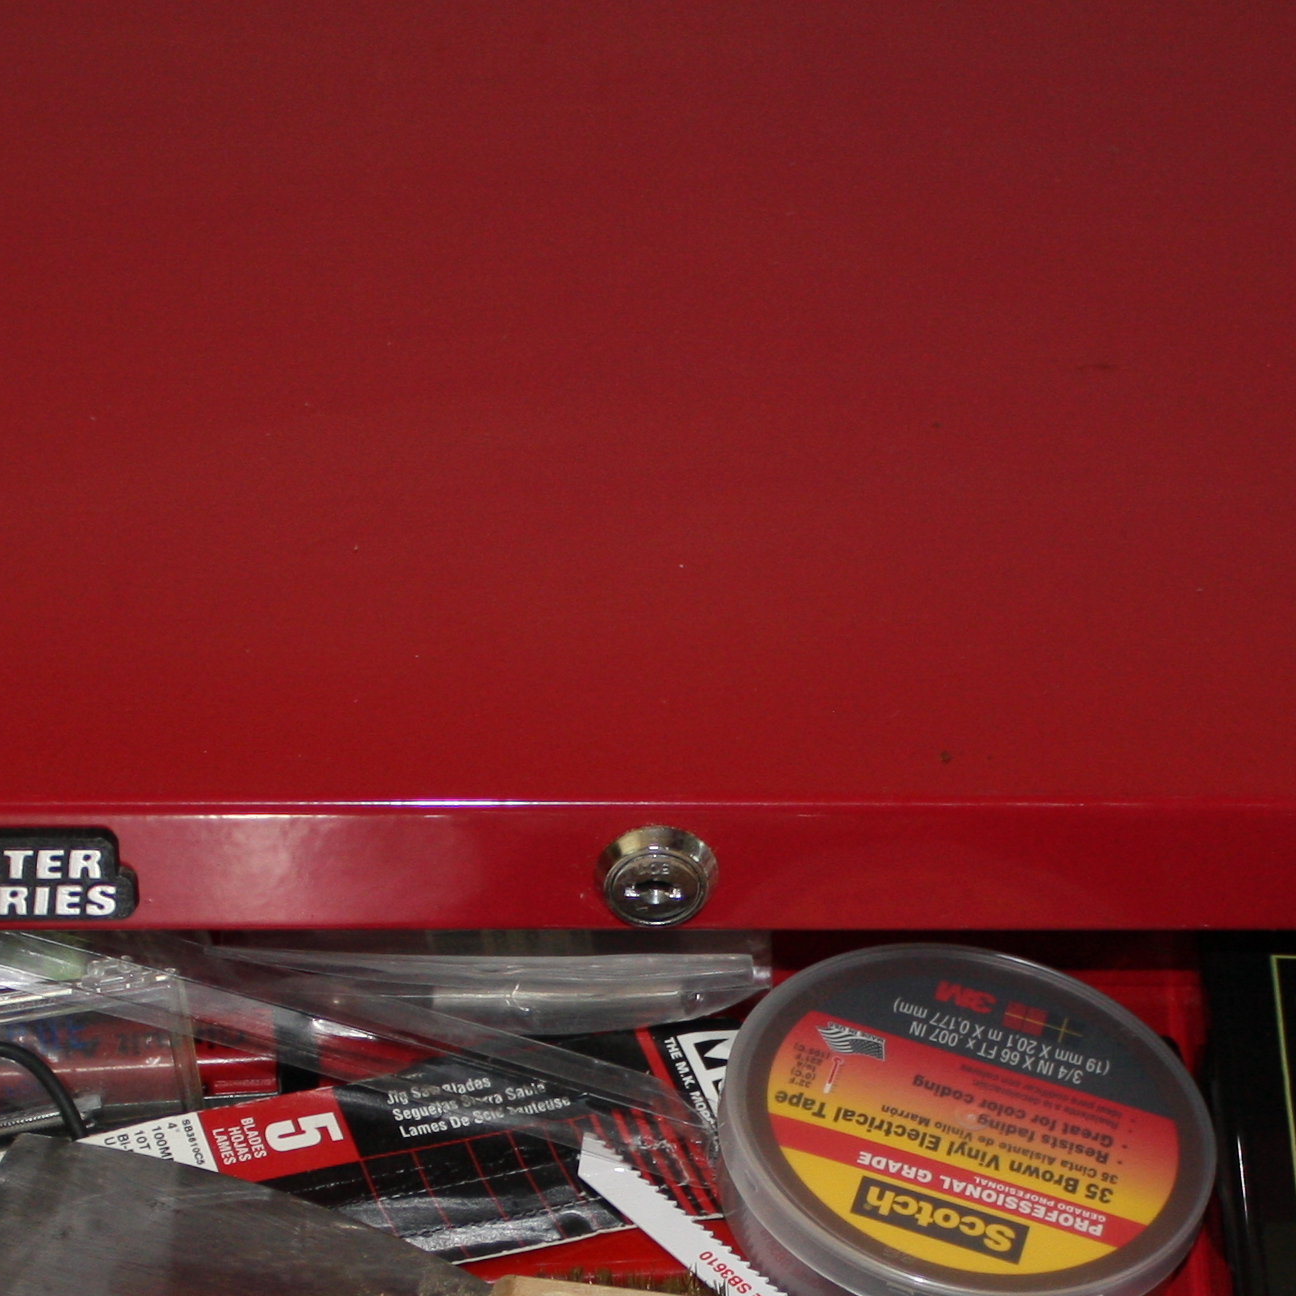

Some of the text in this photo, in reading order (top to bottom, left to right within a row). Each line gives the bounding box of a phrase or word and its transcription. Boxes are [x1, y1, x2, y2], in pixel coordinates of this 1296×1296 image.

[933, 980, 999, 1014] 3M
[893, 998, 927, 1020] mm)
[909, 1021, 927, 1037] IN
[929, 1029, 962, 1047] .007
[987, 1029, 1002, 1042] m
[977, 1043, 998, 1059] FT
[1000, 1049, 1020, 1065] 66
[1054, 1049, 1083, 1066] mm
[664, 1036, 683, 1060] THE
[674, 1061, 695, 1089] M.K.
[1037, 1060, 1054, 1075] IN
[1086, 1059, 1111, 1075] (19
[1057, 1068, 1083, 1084] 3/4
[387, 1090, 409, 1105] Jig
[912, 1075, 1113, 1148] Great for color coding
[265, 1112, 344, 1152] 5
[398, 1120, 448, 1138] Lames
[450, 1115, 471, 1130] De
[934, 1122, 972, 1141] Vinilo
[212, 1128, 237, 1166] LAMES
[227, 1126, 252, 1162] HOJAS
[240, 1117, 267, 1159] BLADES
[775, 1091, 1113, 1204] 35 Brown Vinyl Electrical Tape
[977, 1114, 1109, 1164] Resists fading
[978, 1137, 994, 1147] de
[1060, 1160, 1097, 1178] Cinta
[857, 1151, 1104, 1236] PROFESSIONAL GRADE
[974, 1176, 1106, 1222] GERADO PROFESIONAL
[865, 1186, 1016, 1251] Scotch
[699, 1251, 752, 1294] SB3610
